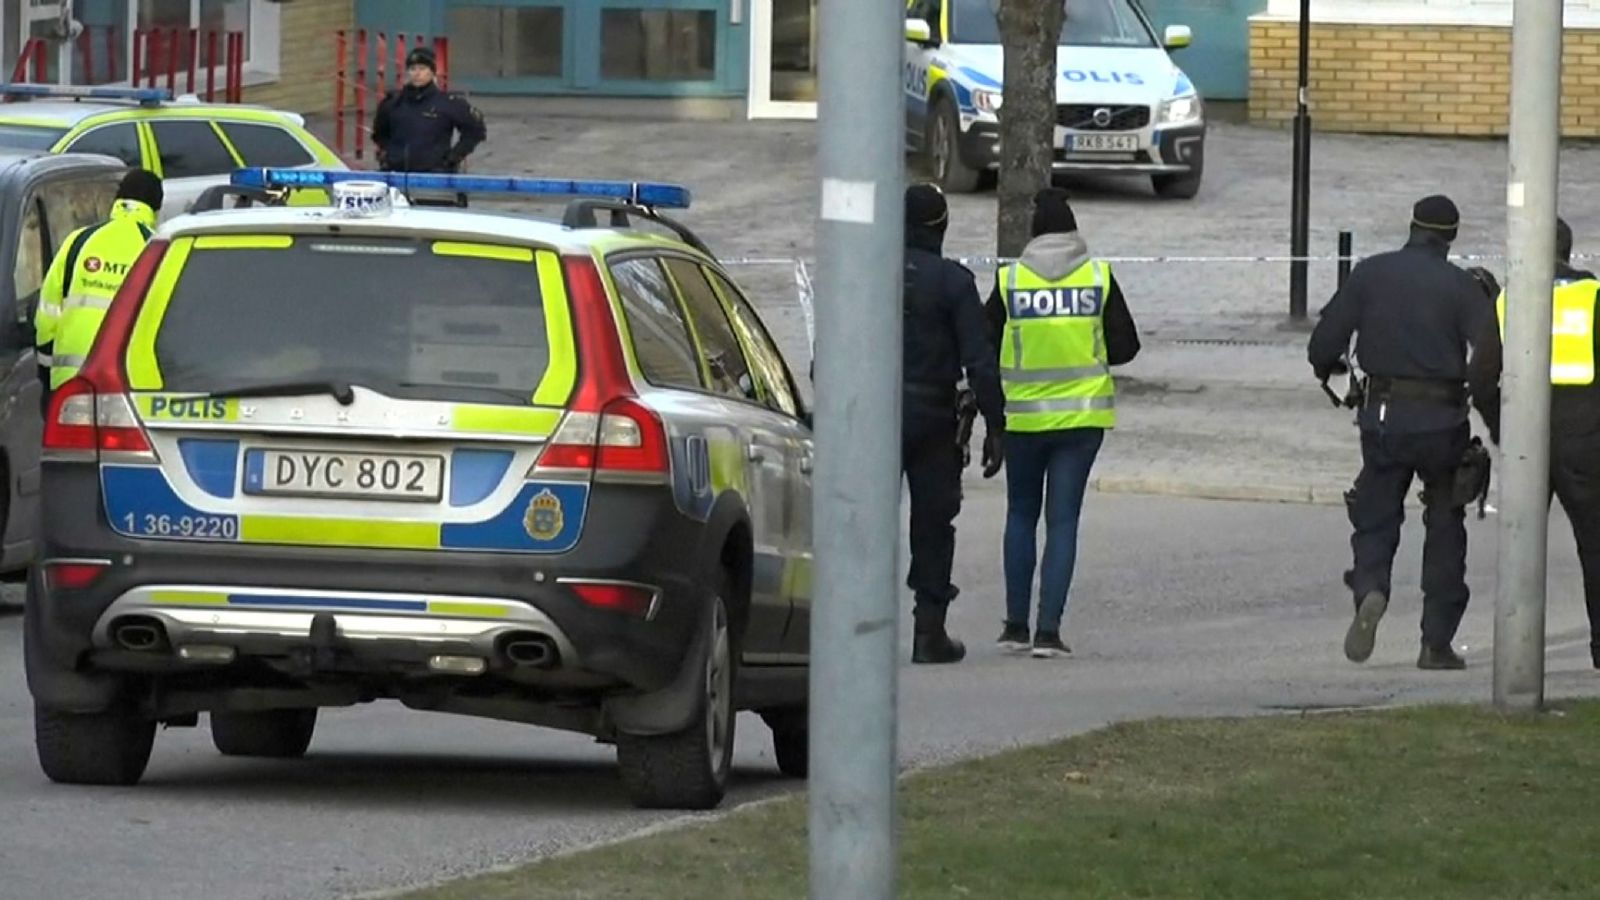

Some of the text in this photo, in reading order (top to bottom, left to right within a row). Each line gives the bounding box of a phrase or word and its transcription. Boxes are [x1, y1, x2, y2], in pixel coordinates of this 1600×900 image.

[1062, 69, 1145, 85] OLIS
[103, 261, 128, 275] MT
[1012, 287, 1097, 317] POLIS
[151, 396, 226, 418] POLIS
[276, 455, 425, 492] DYC 802
[124, 512, 236, 538] 1 36-9220
